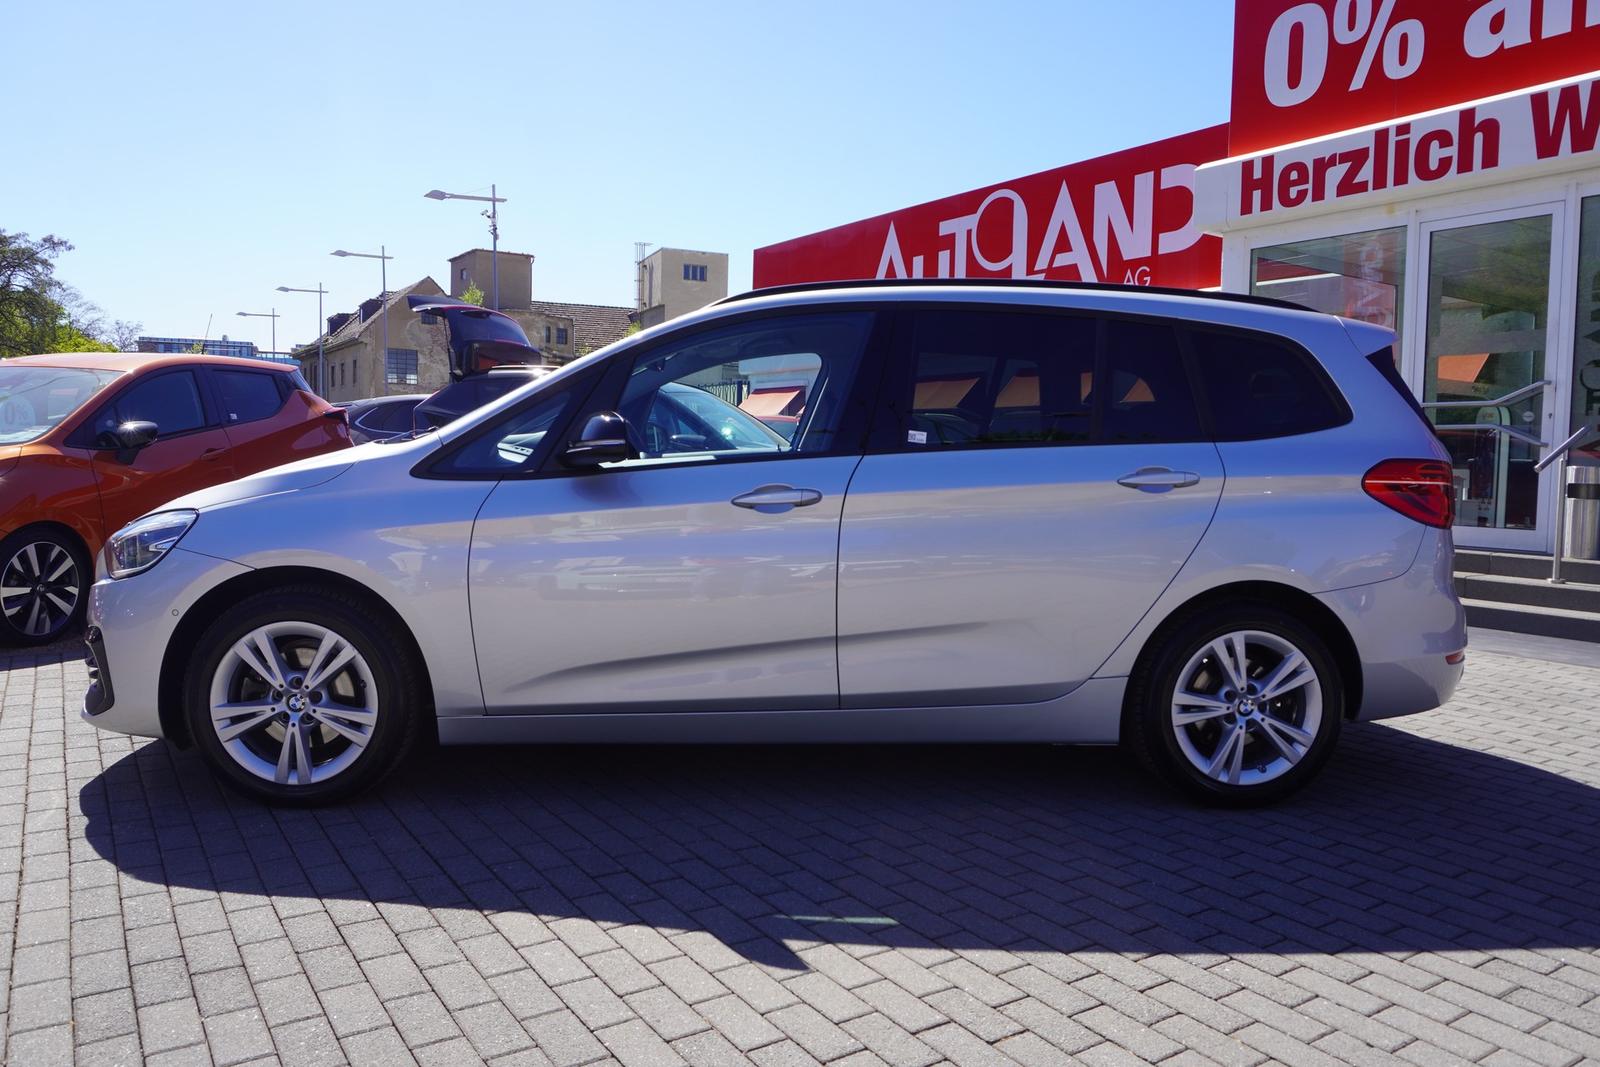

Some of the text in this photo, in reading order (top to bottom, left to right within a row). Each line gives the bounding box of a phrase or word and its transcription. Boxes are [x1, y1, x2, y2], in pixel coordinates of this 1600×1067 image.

[1264, 0, 1425, 107] 0%
[1240, 80, 1600, 216] Herzlich W
[1123, 265, 1151, 287] AG
